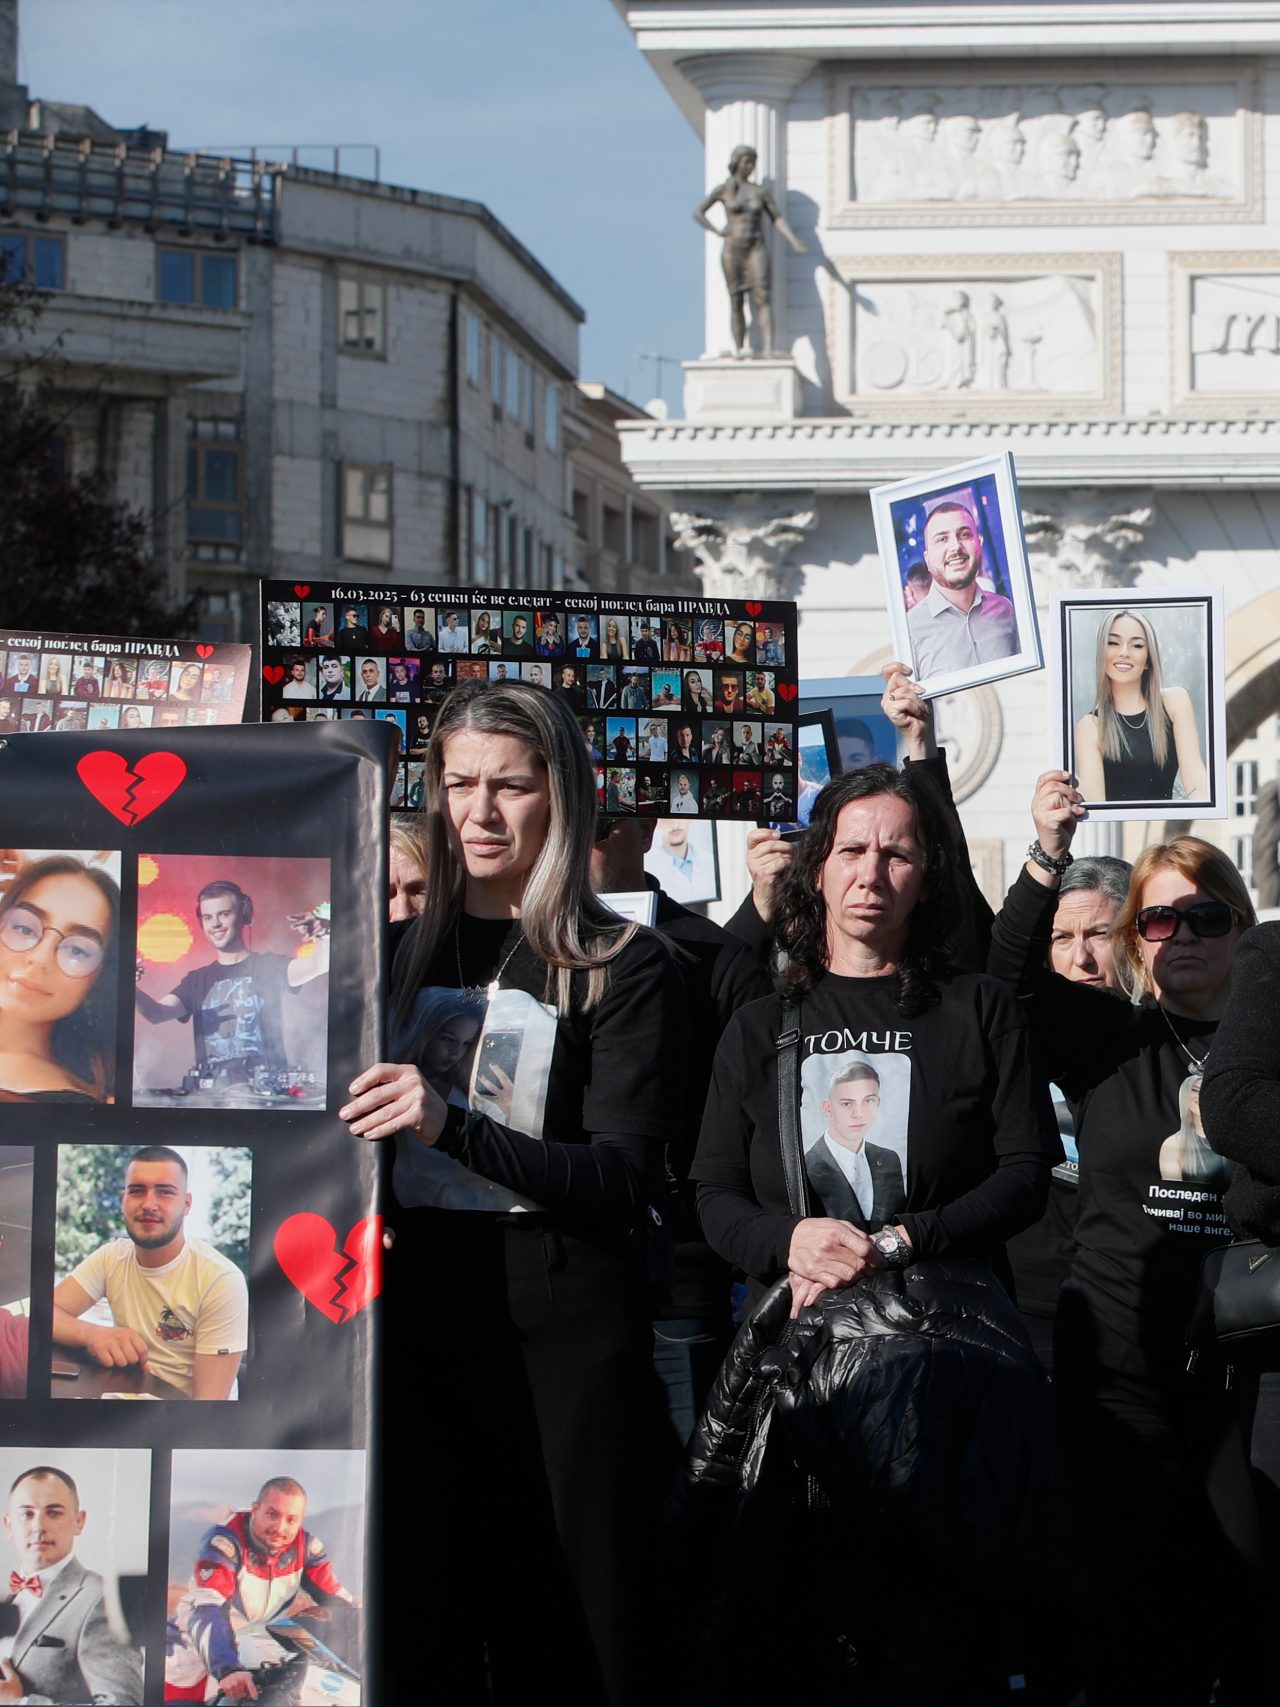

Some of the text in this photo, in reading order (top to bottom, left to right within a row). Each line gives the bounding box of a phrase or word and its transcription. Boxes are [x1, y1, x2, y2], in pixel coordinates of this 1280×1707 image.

[331, 587, 398, 602] 16.03.2025
[410, 590, 425, 603] 63
[428, 593, 467, 604] сенки
[472, 590, 487, 605] ќе
[491, 595, 505, 605] ве
[508, 595, 552, 607] следат
[565, 596, 597, 611] секој
[601, 599, 643, 613] поглед
[646, 599, 675, 615] бара
[678, 600, 731, 616] ПРАВДА
[7, 636, 41, 650] секој
[45, 639, 88, 653] поглед
[91, 639, 121, 653] бара
[125, 642, 180, 657] ПРАВДА
[805, 1028, 913, 1053] ТОМЧЕ
[1149, 1185, 1217, 1202] Последен
[1187, 1211, 1202, 1220] во
[1168, 1222, 1201, 1233] наше
